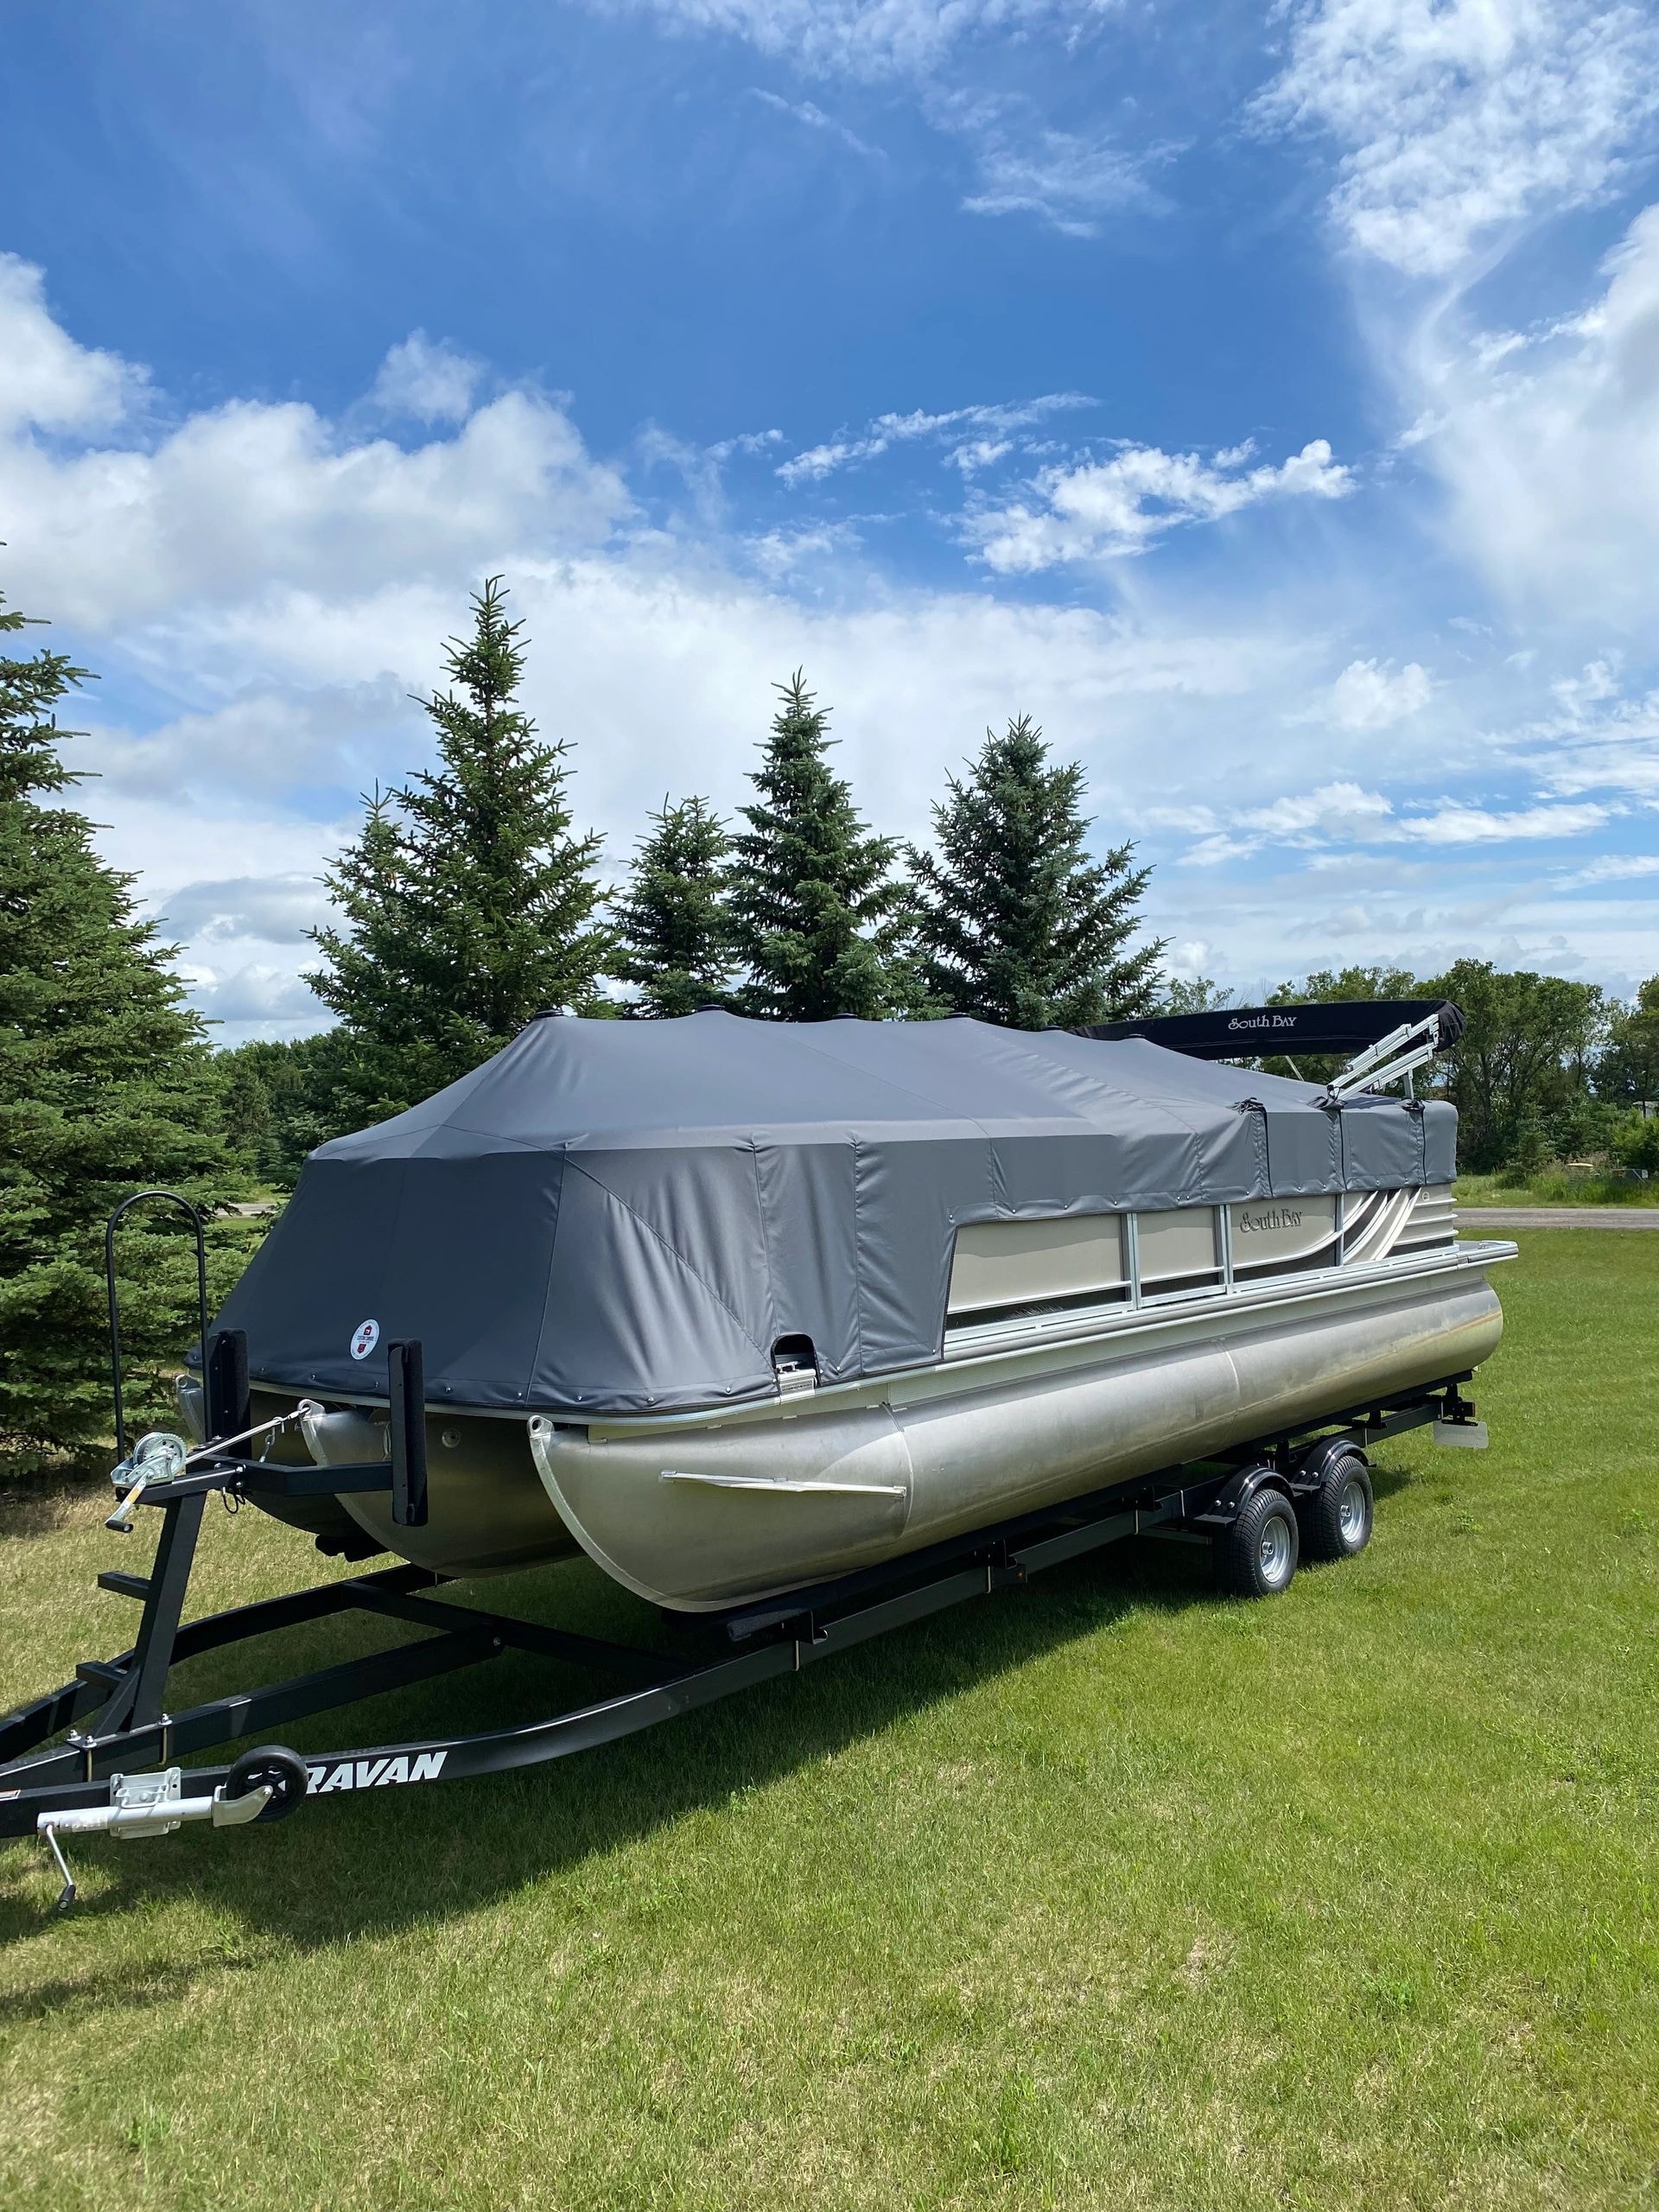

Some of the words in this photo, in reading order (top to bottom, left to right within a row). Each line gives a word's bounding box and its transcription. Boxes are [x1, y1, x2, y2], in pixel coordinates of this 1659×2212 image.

[1228, 1014, 1270, 1030] South
[1240, 1209, 1281, 1233] South
[306, 1751, 448, 1795] RAVAN
